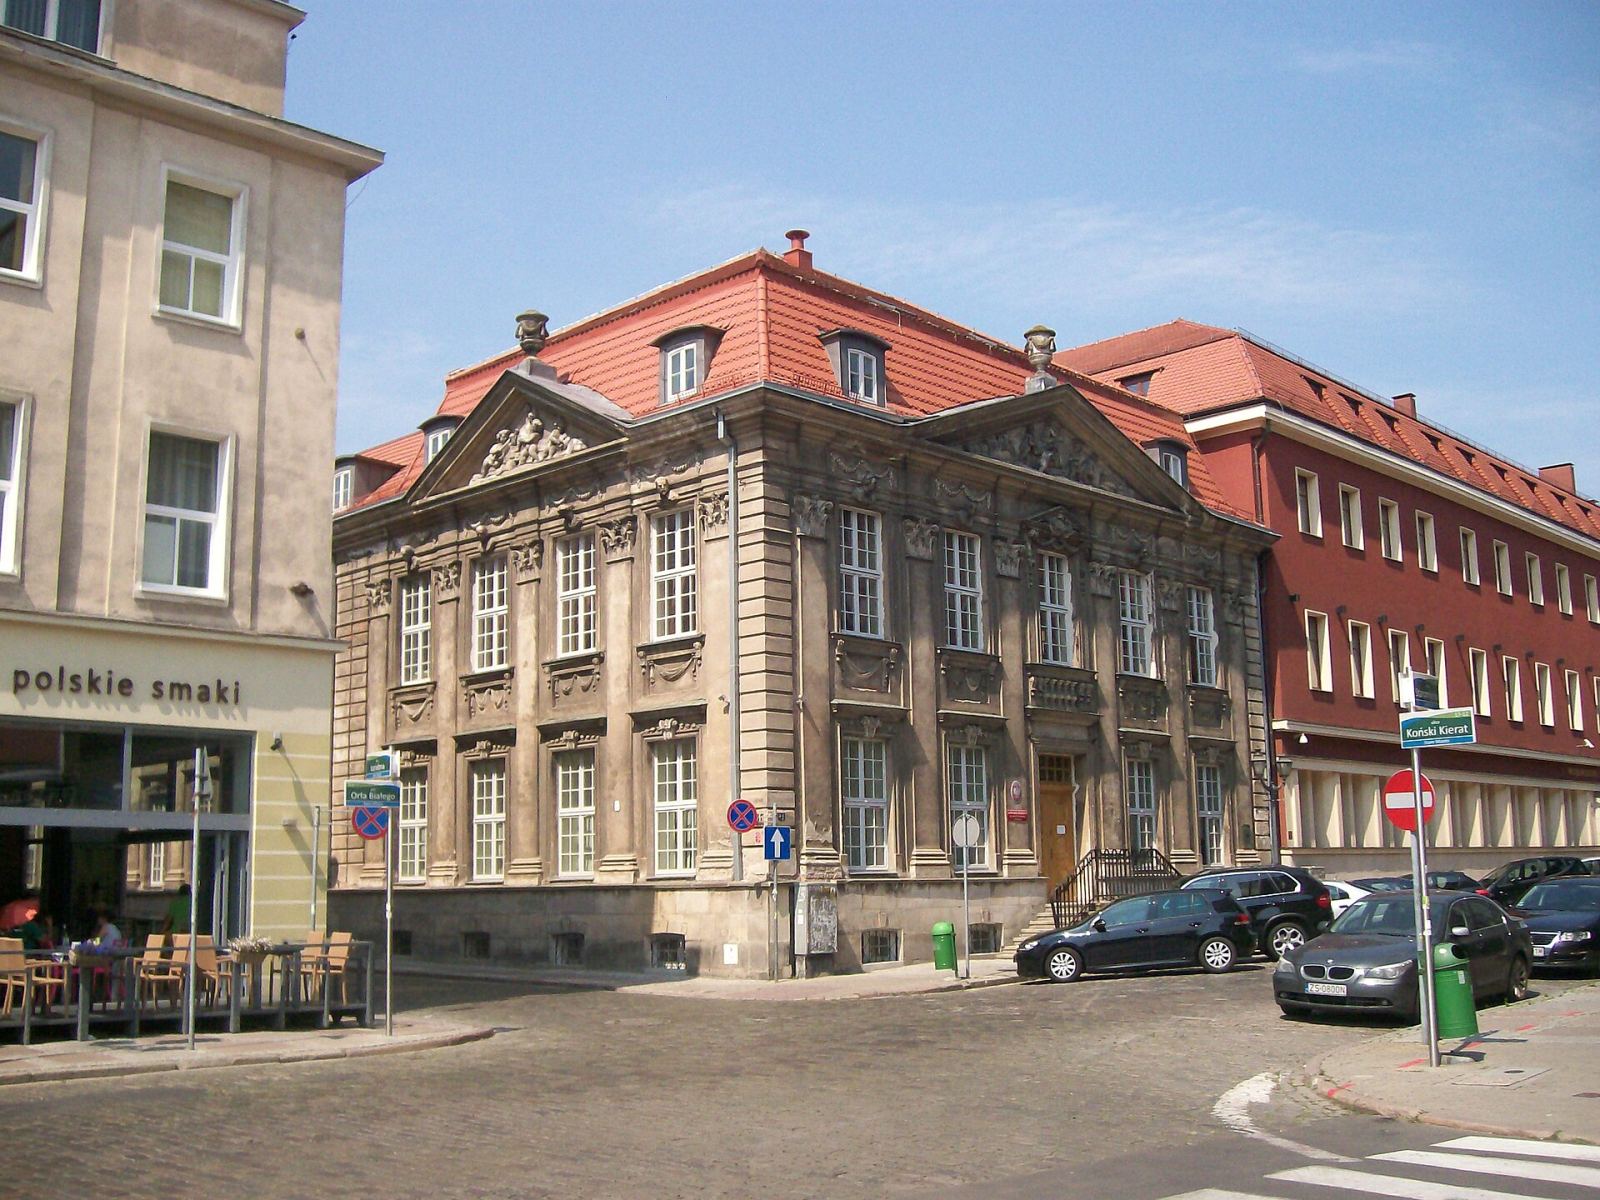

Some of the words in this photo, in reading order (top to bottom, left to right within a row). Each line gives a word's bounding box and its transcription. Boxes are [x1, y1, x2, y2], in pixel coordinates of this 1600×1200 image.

[13, 665, 134, 697] polskie
[152, 678, 240, 705] smaki
[1406, 726, 1437, 738] Koński
[1439, 724, 1469, 735] Kierat
